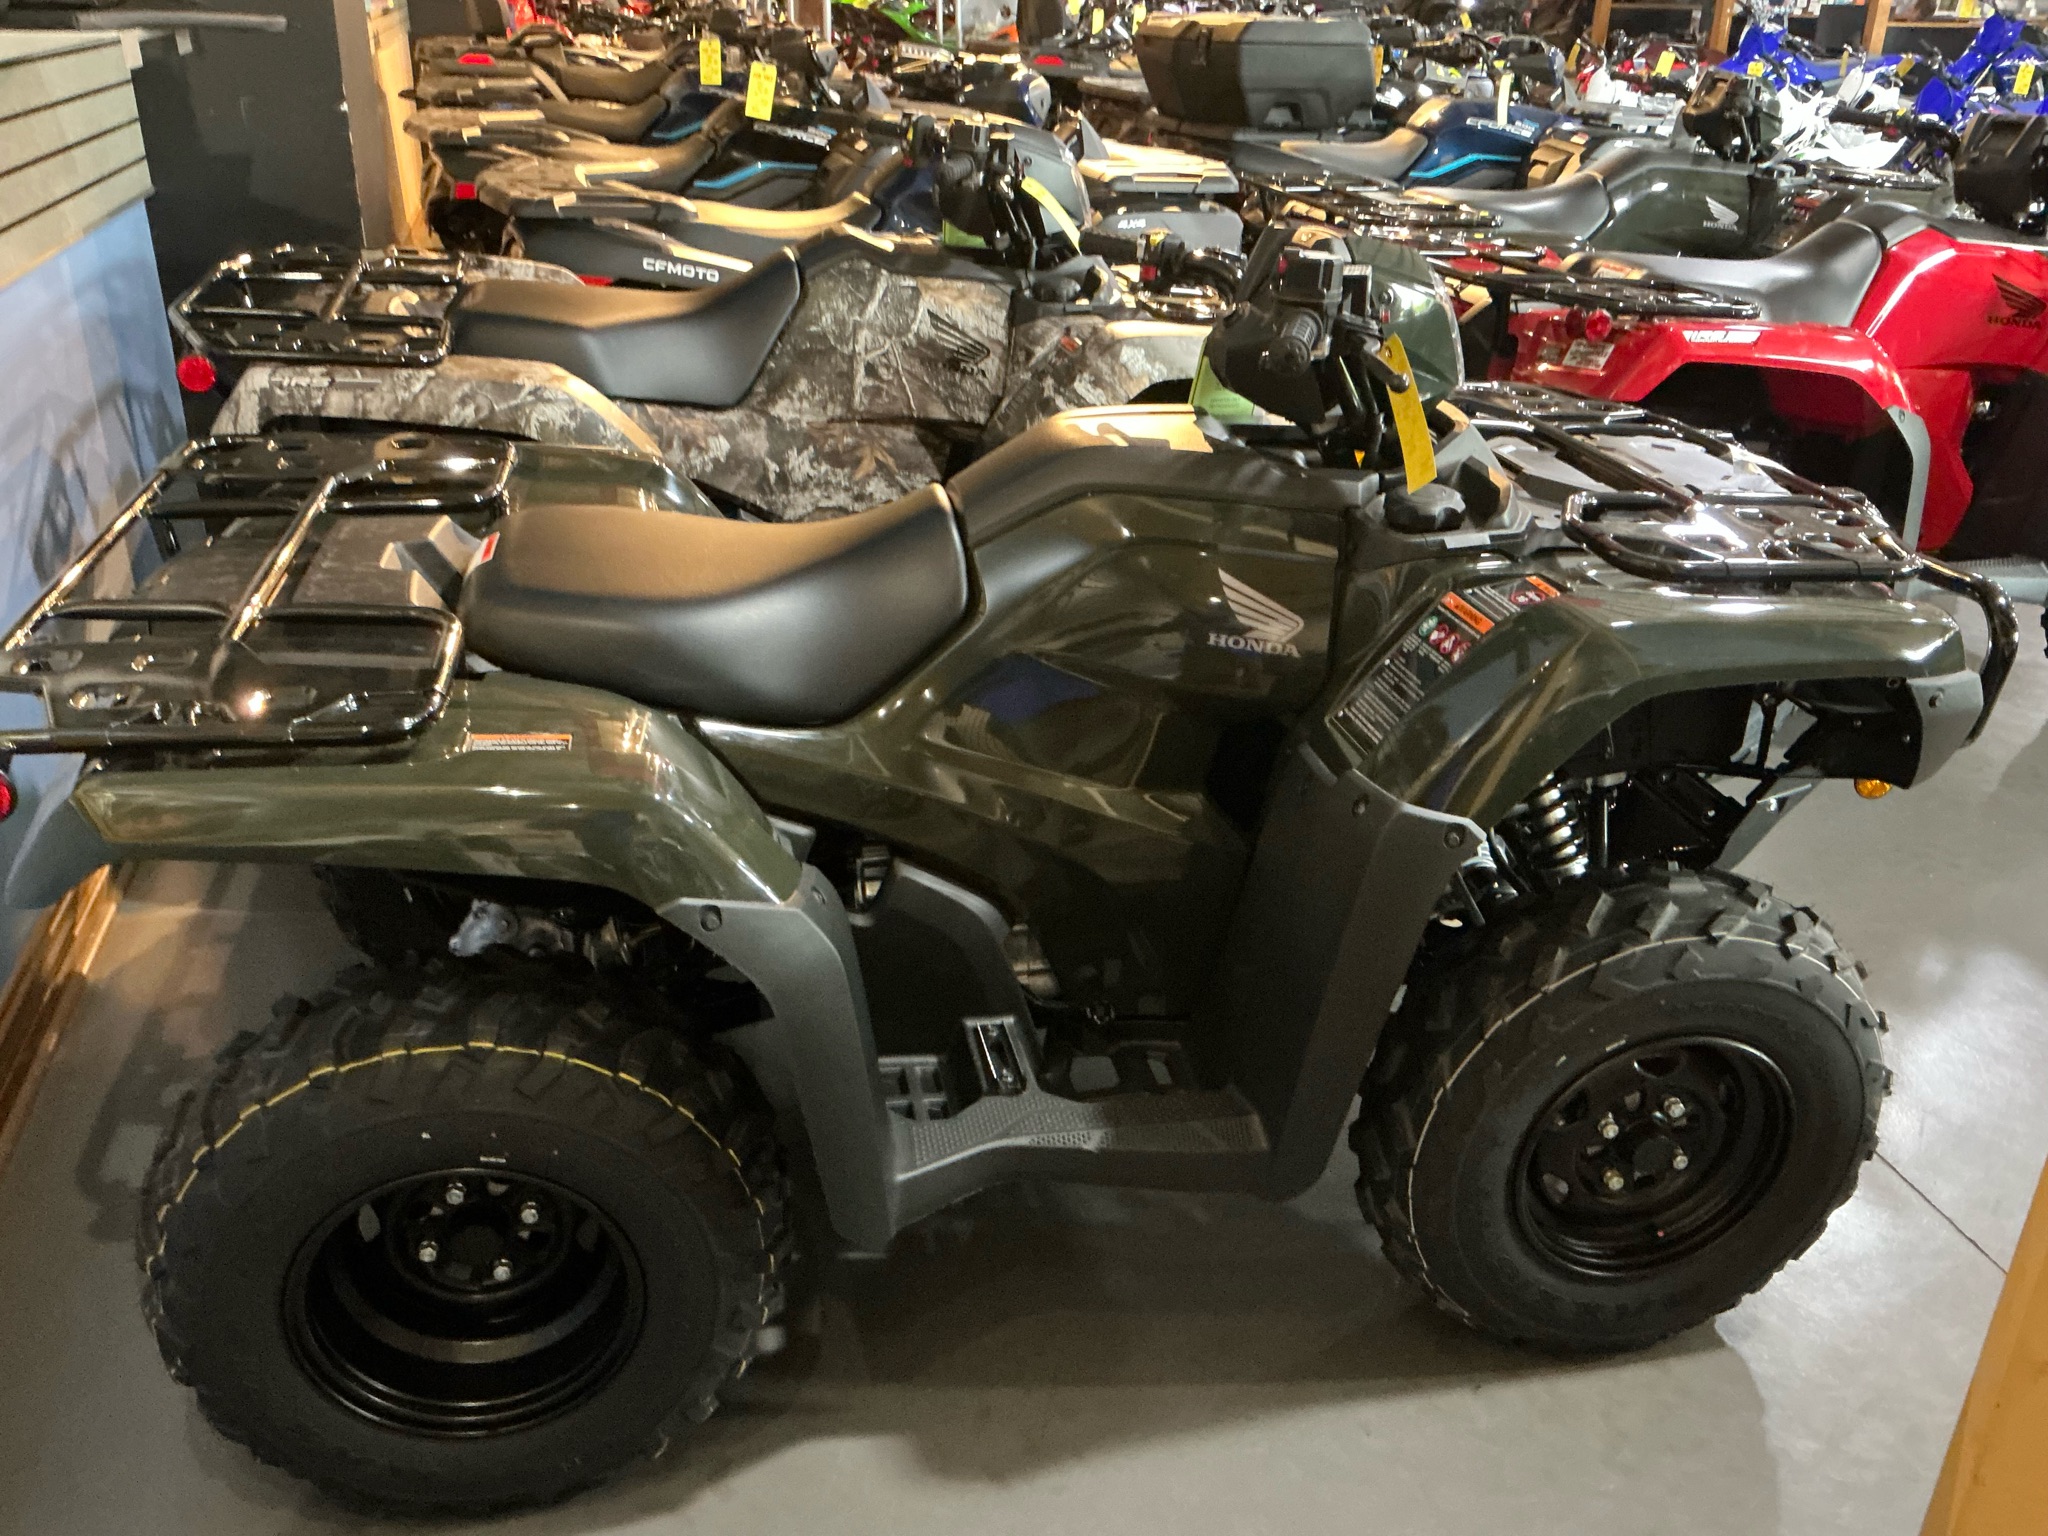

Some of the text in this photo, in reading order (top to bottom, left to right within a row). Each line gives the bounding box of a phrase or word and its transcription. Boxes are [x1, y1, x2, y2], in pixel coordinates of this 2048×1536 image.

[1702, 220, 1738, 231] HONDA
[642, 257, 720, 283] CFMOTO
[1987, 315, 2042, 329] HONDA
[1207, 632, 1301, 658] HONDA
